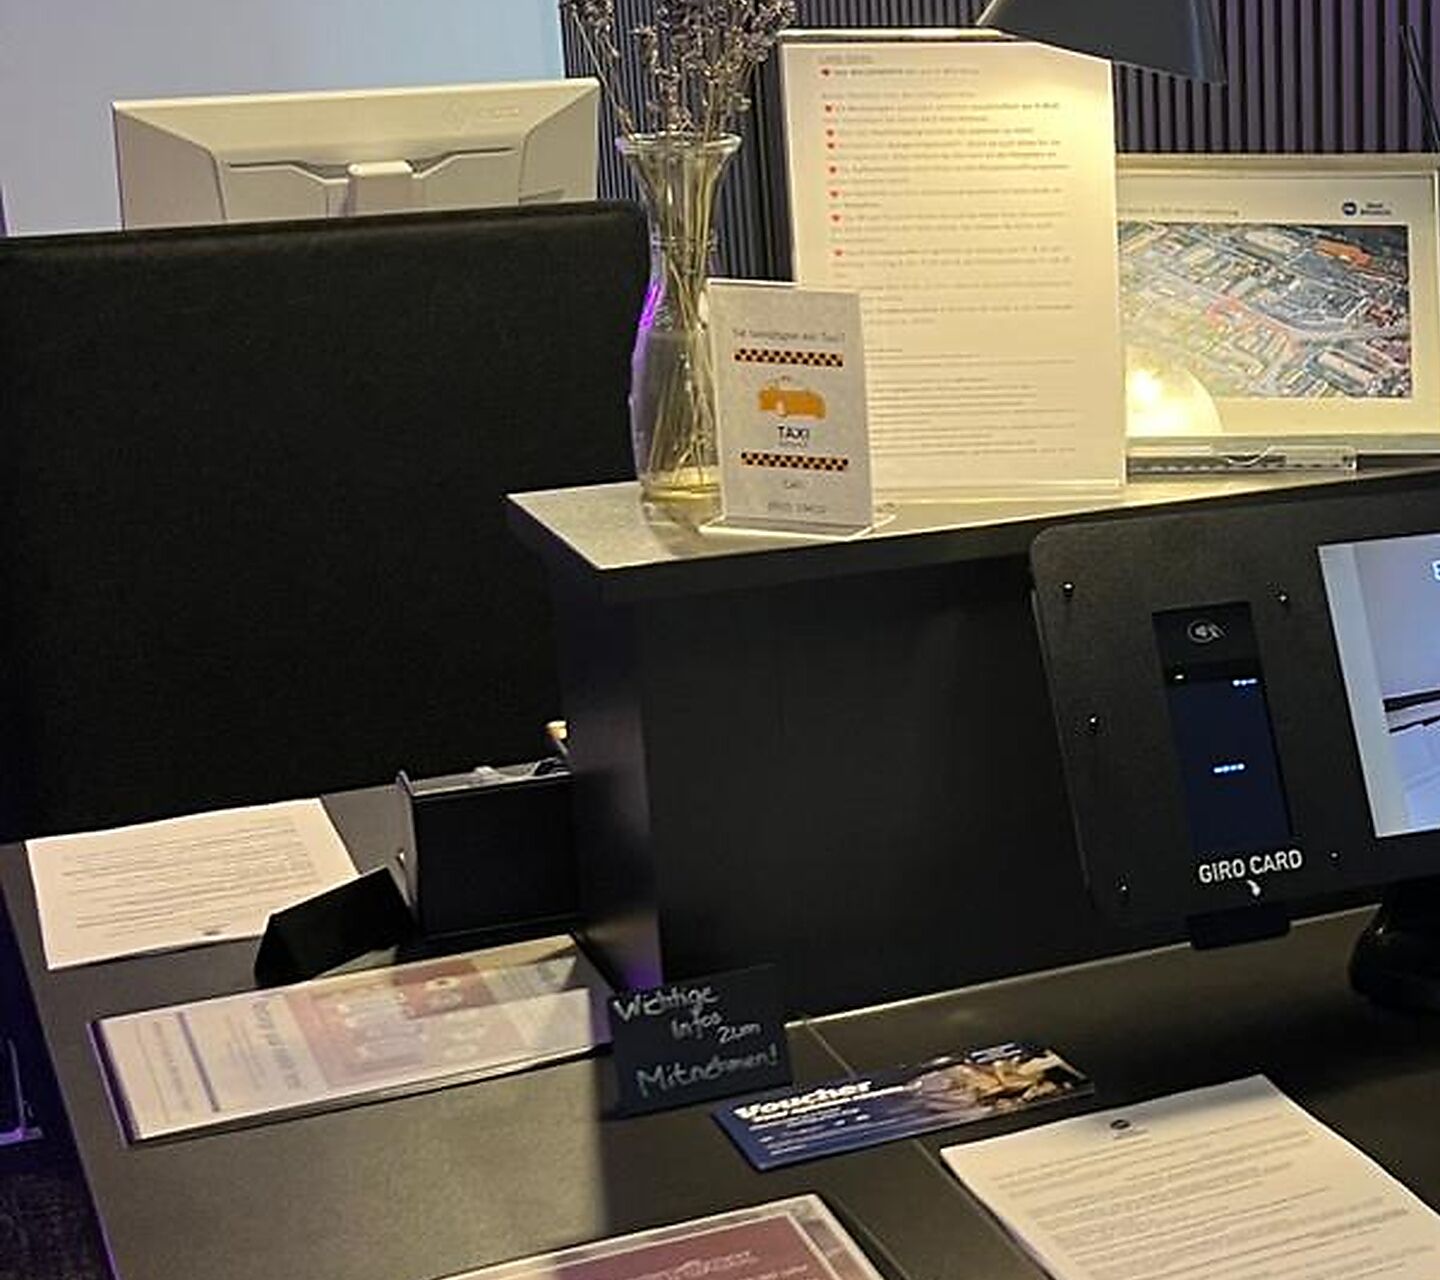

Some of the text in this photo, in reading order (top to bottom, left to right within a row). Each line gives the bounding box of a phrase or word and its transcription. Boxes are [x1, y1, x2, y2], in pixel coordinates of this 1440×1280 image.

[776, 425, 811, 440] TAXI
[1198, 848, 1304, 884] GIRO CARD
[613, 985, 721, 1021] Wichtige
[670, 1011, 723, 1040] Infos
[635, 1042, 778, 1100] Mitnehmen!
[733, 1078, 873, 1120] Voucher
